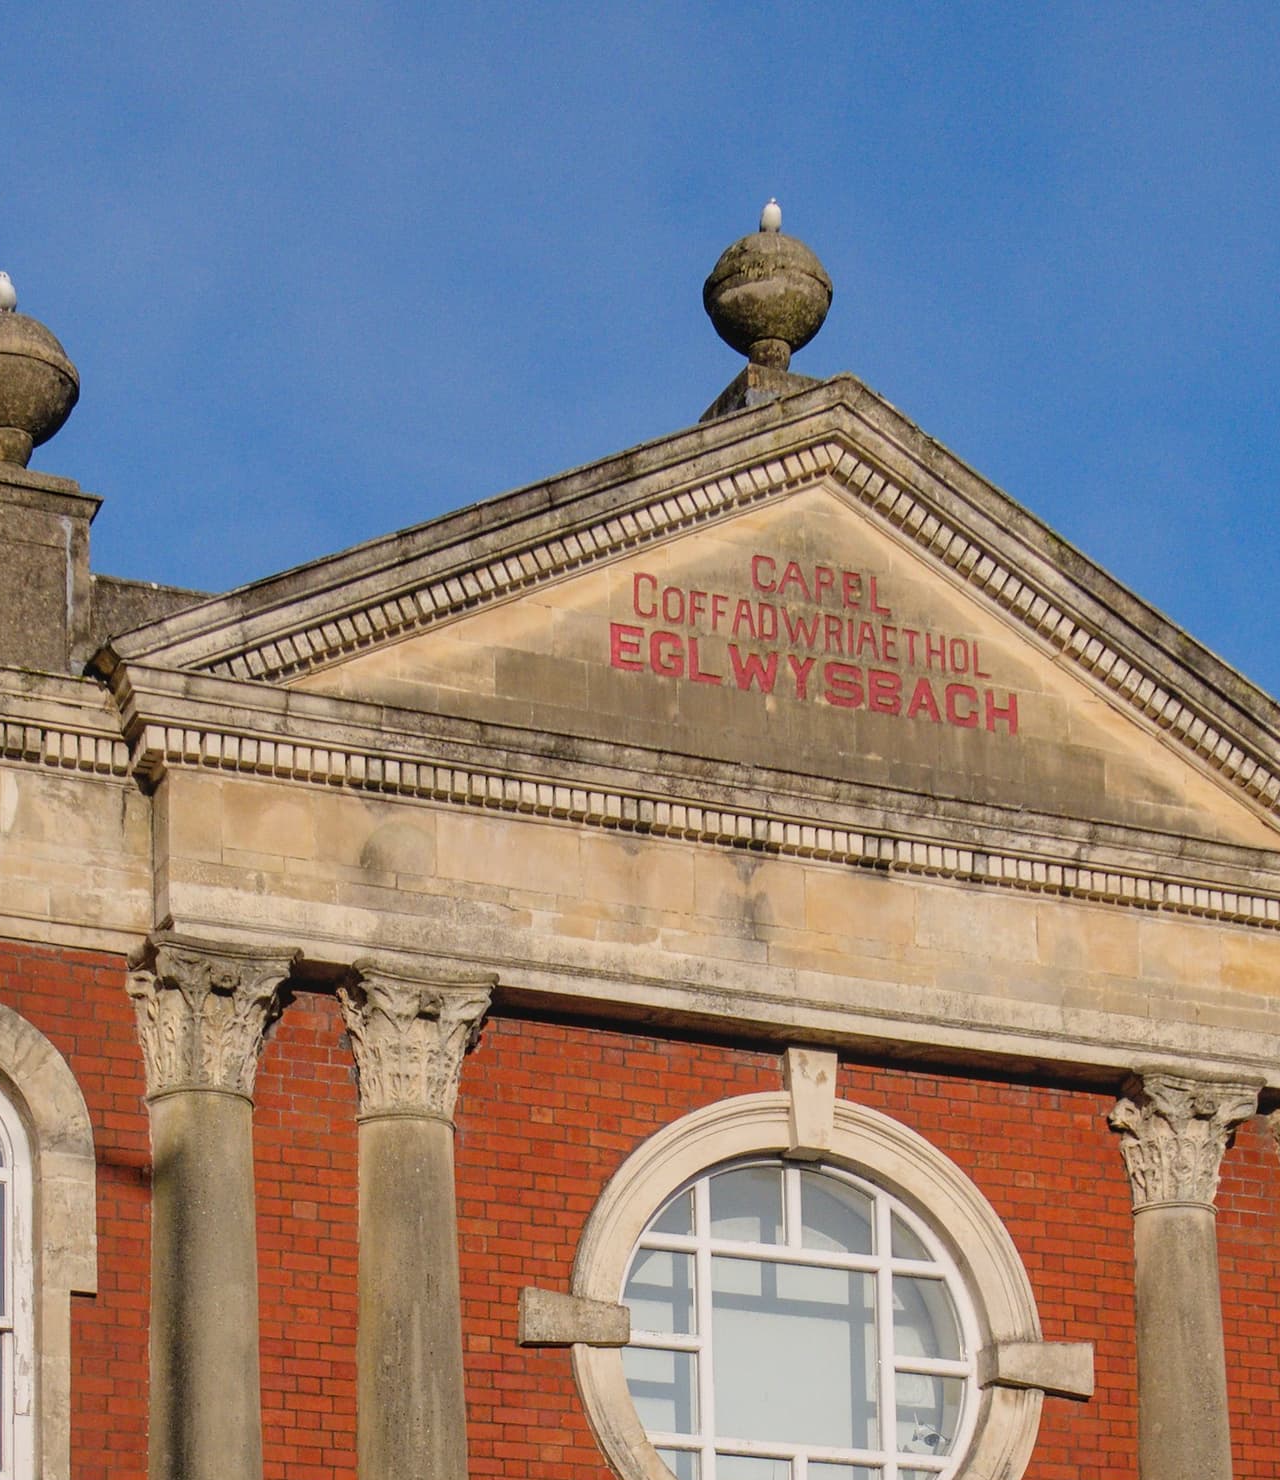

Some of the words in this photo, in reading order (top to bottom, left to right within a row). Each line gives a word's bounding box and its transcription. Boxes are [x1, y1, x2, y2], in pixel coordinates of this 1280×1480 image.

[633, 572, 992, 680] COFFADWRIAETHOL
[752, 554, 892, 616] CAPEL
[610, 622, 1018, 735] EGLWYSBACH
